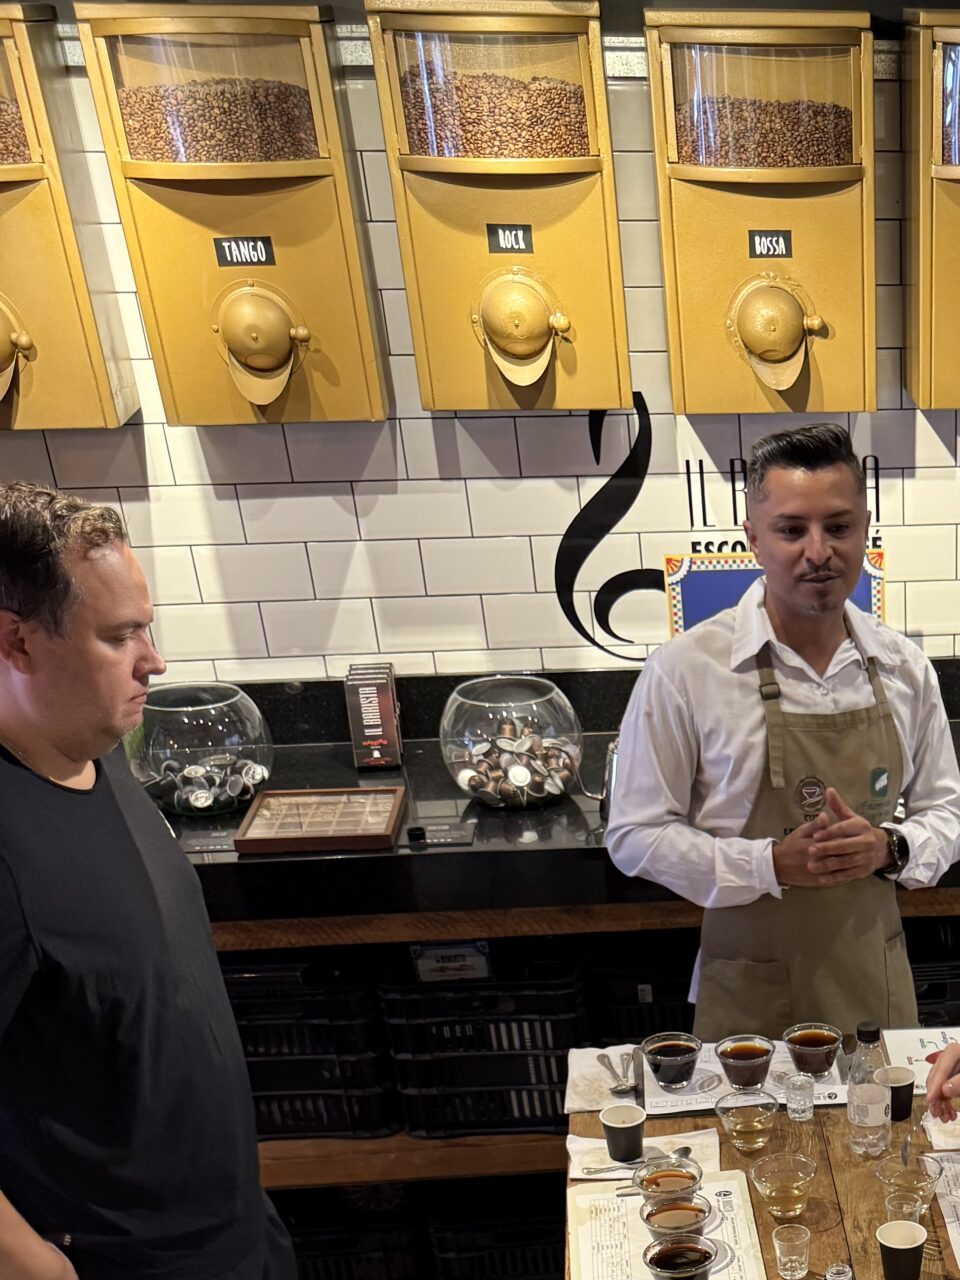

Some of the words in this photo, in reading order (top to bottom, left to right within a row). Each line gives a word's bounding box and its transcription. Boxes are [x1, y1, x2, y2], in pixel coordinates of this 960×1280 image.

[498, 229, 525, 249] ROCK
[754, 235, 786, 255] BOSSA
[222, 241, 266, 262] TANGO
[684, 459, 716, 528] IL
[359, 687, 381, 725] BARISTA
[363, 727, 383, 735] IL
